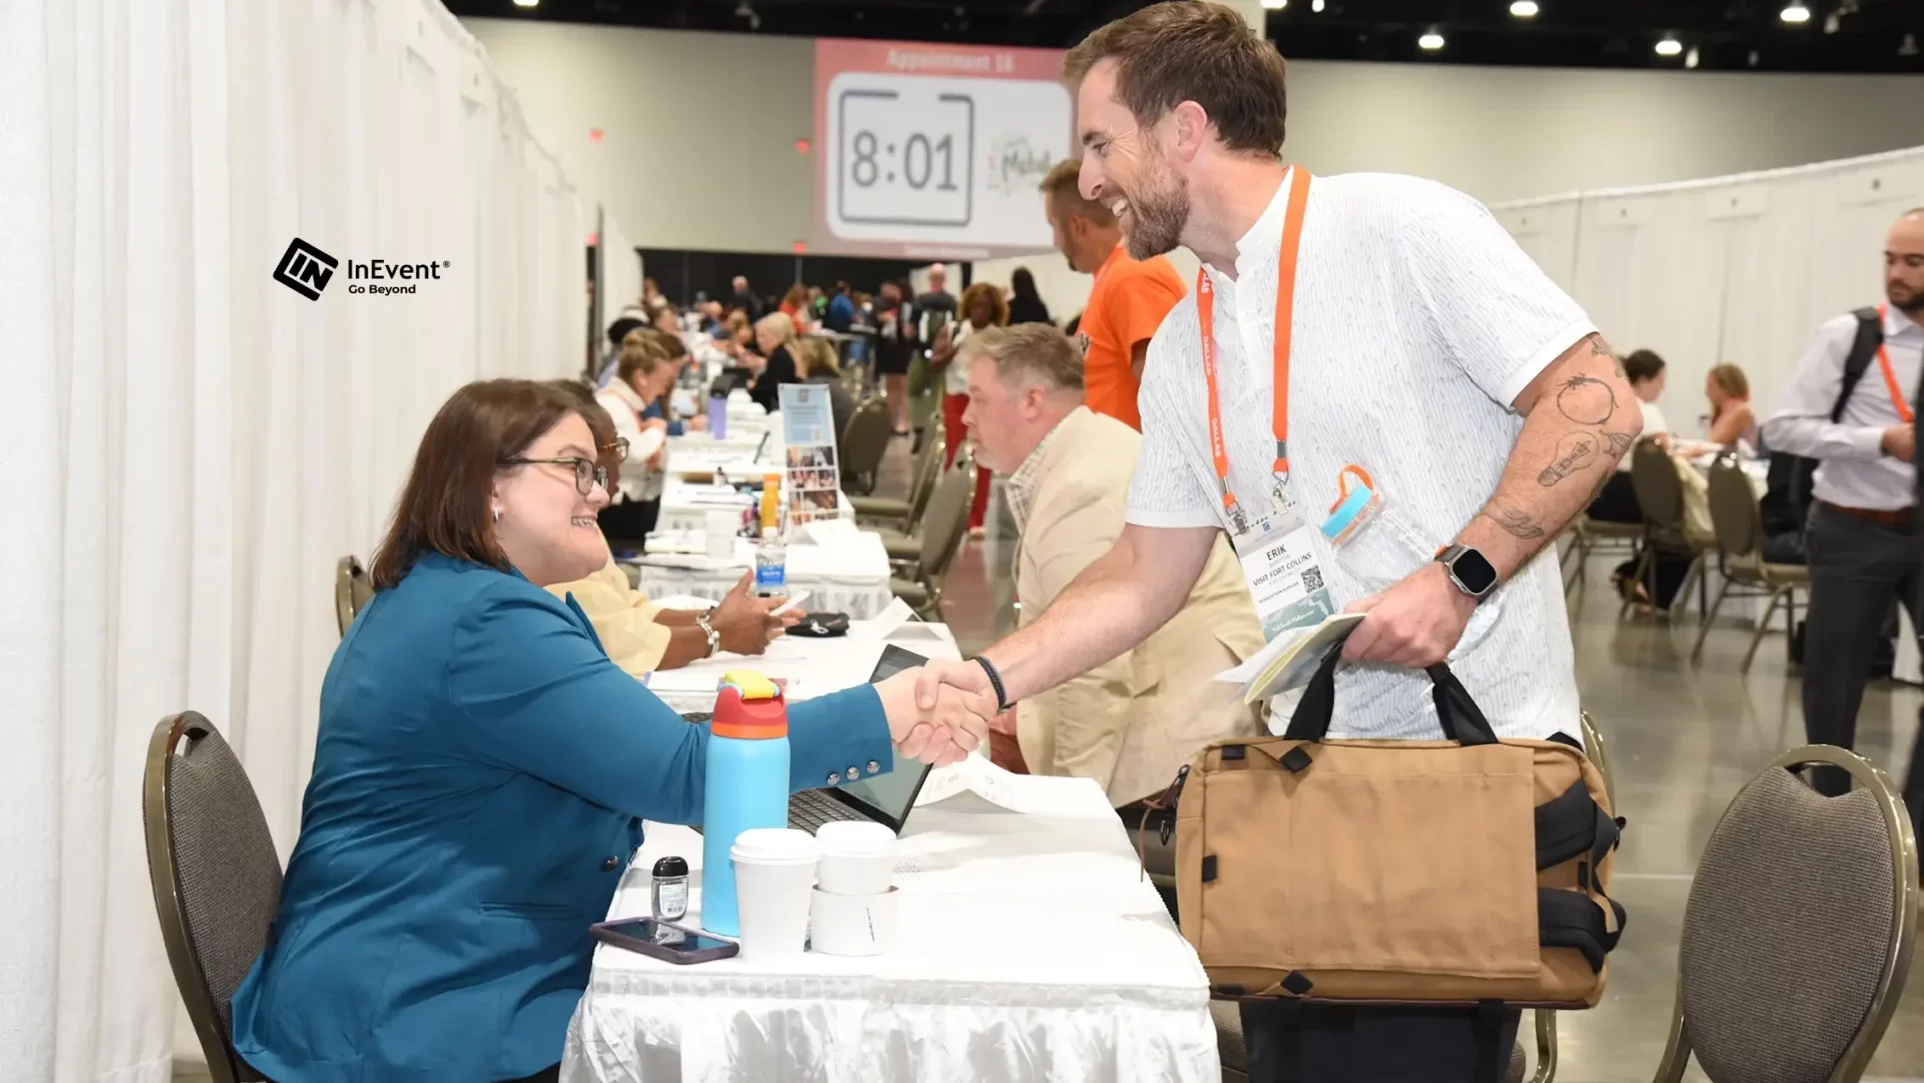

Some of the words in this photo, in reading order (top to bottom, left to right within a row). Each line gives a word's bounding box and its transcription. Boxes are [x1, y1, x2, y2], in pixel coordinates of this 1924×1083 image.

[851, 130, 958, 190] 8:01
[1202, 335, 1211, 376] DALLAS
[1211, 417, 1221, 458] DALLAS
[1253, 573, 1269, 586] VISIT
[1269, 565, 1286, 579] FORT
[1286, 552, 1312, 570] COLLINS
[1266, 544, 1287, 561] ERIK
